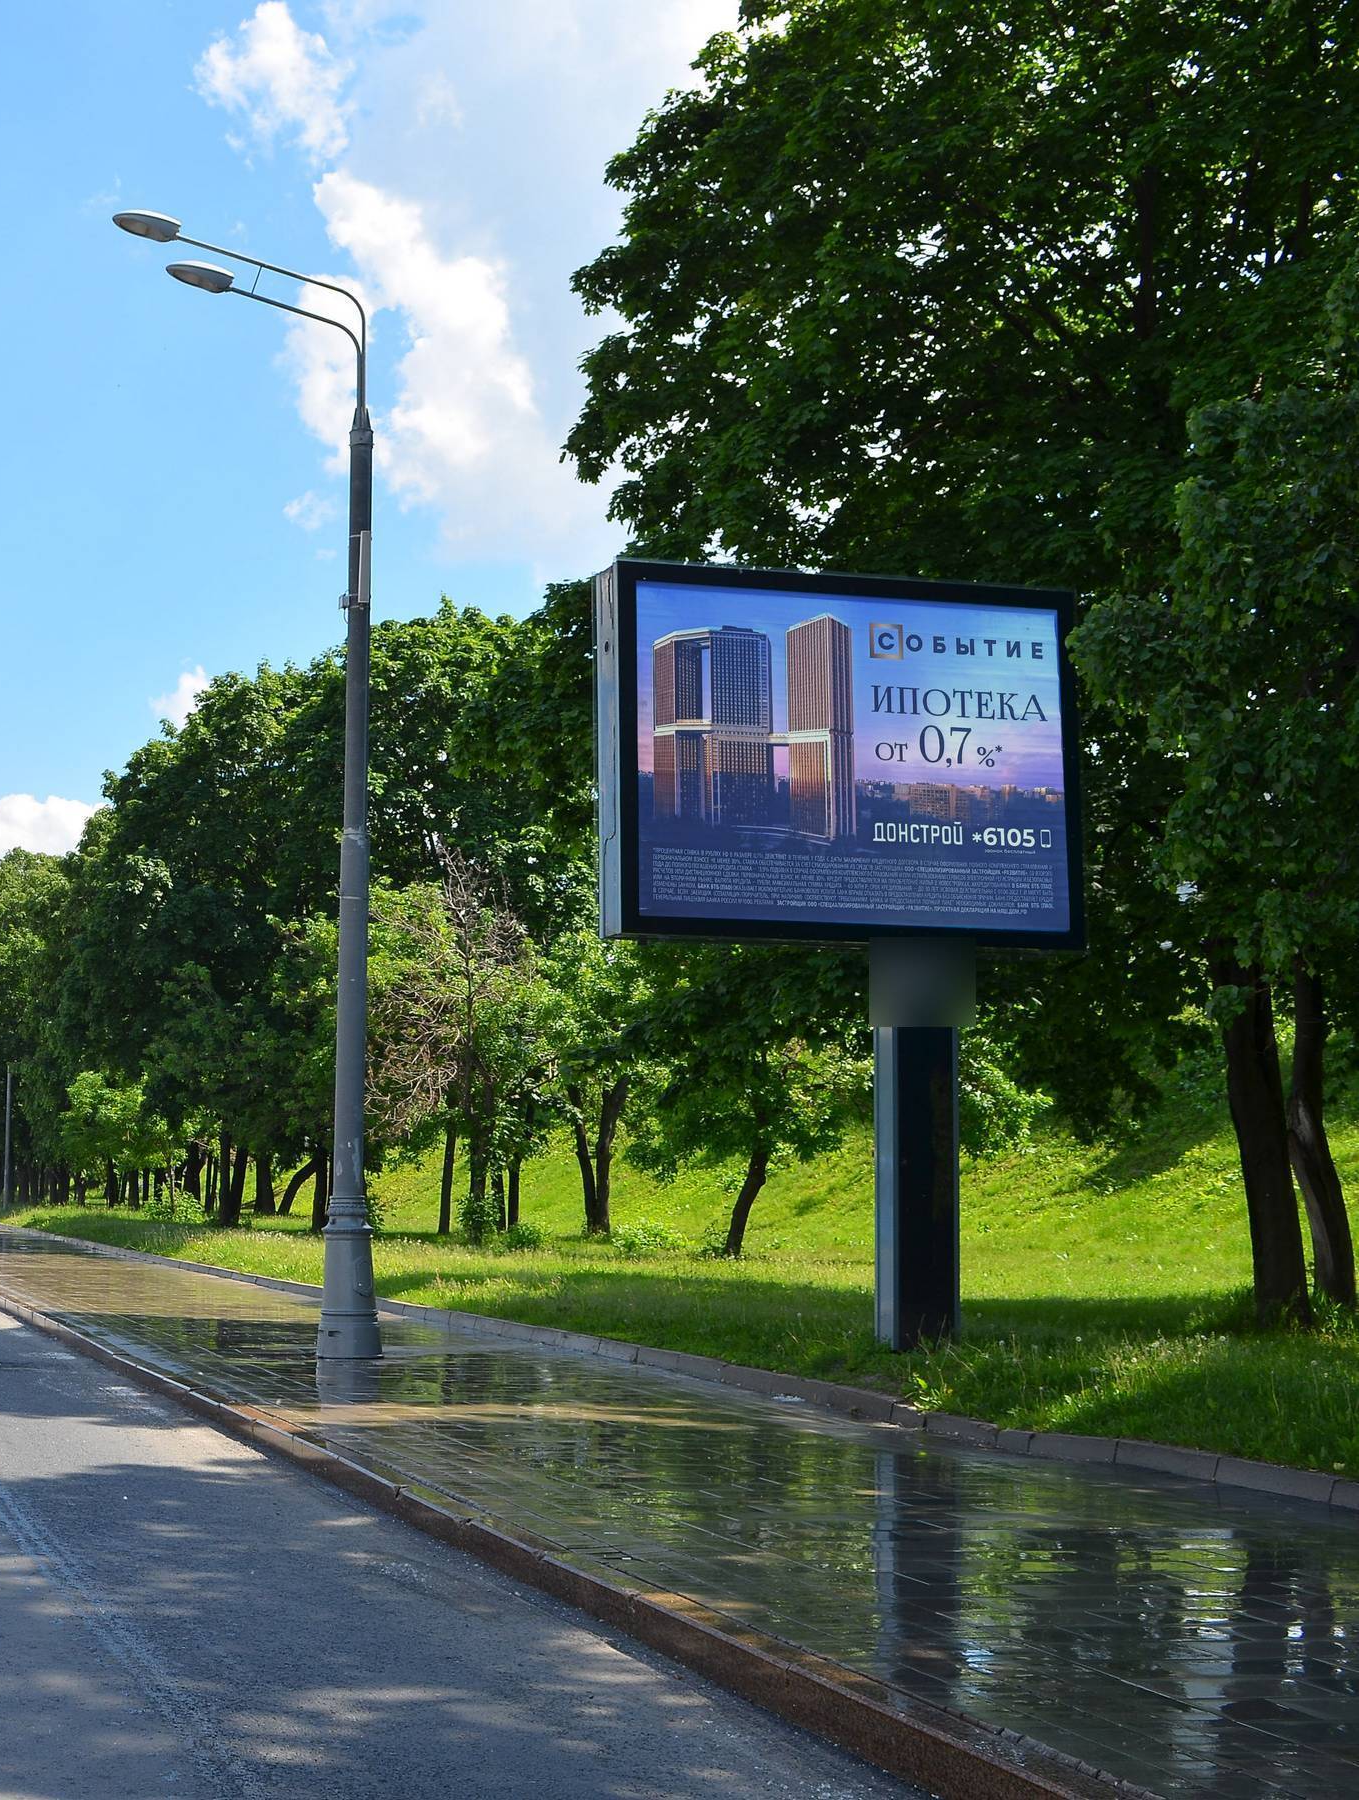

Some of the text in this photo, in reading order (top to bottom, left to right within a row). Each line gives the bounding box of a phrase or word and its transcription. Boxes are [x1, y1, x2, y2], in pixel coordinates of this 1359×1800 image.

[877, 632, 1044, 660] СОБЫТИЕ
[871, 685, 1048, 722] ИПОТЕКА
[873, 821, 963, 845] ДОНСТРОЙ
